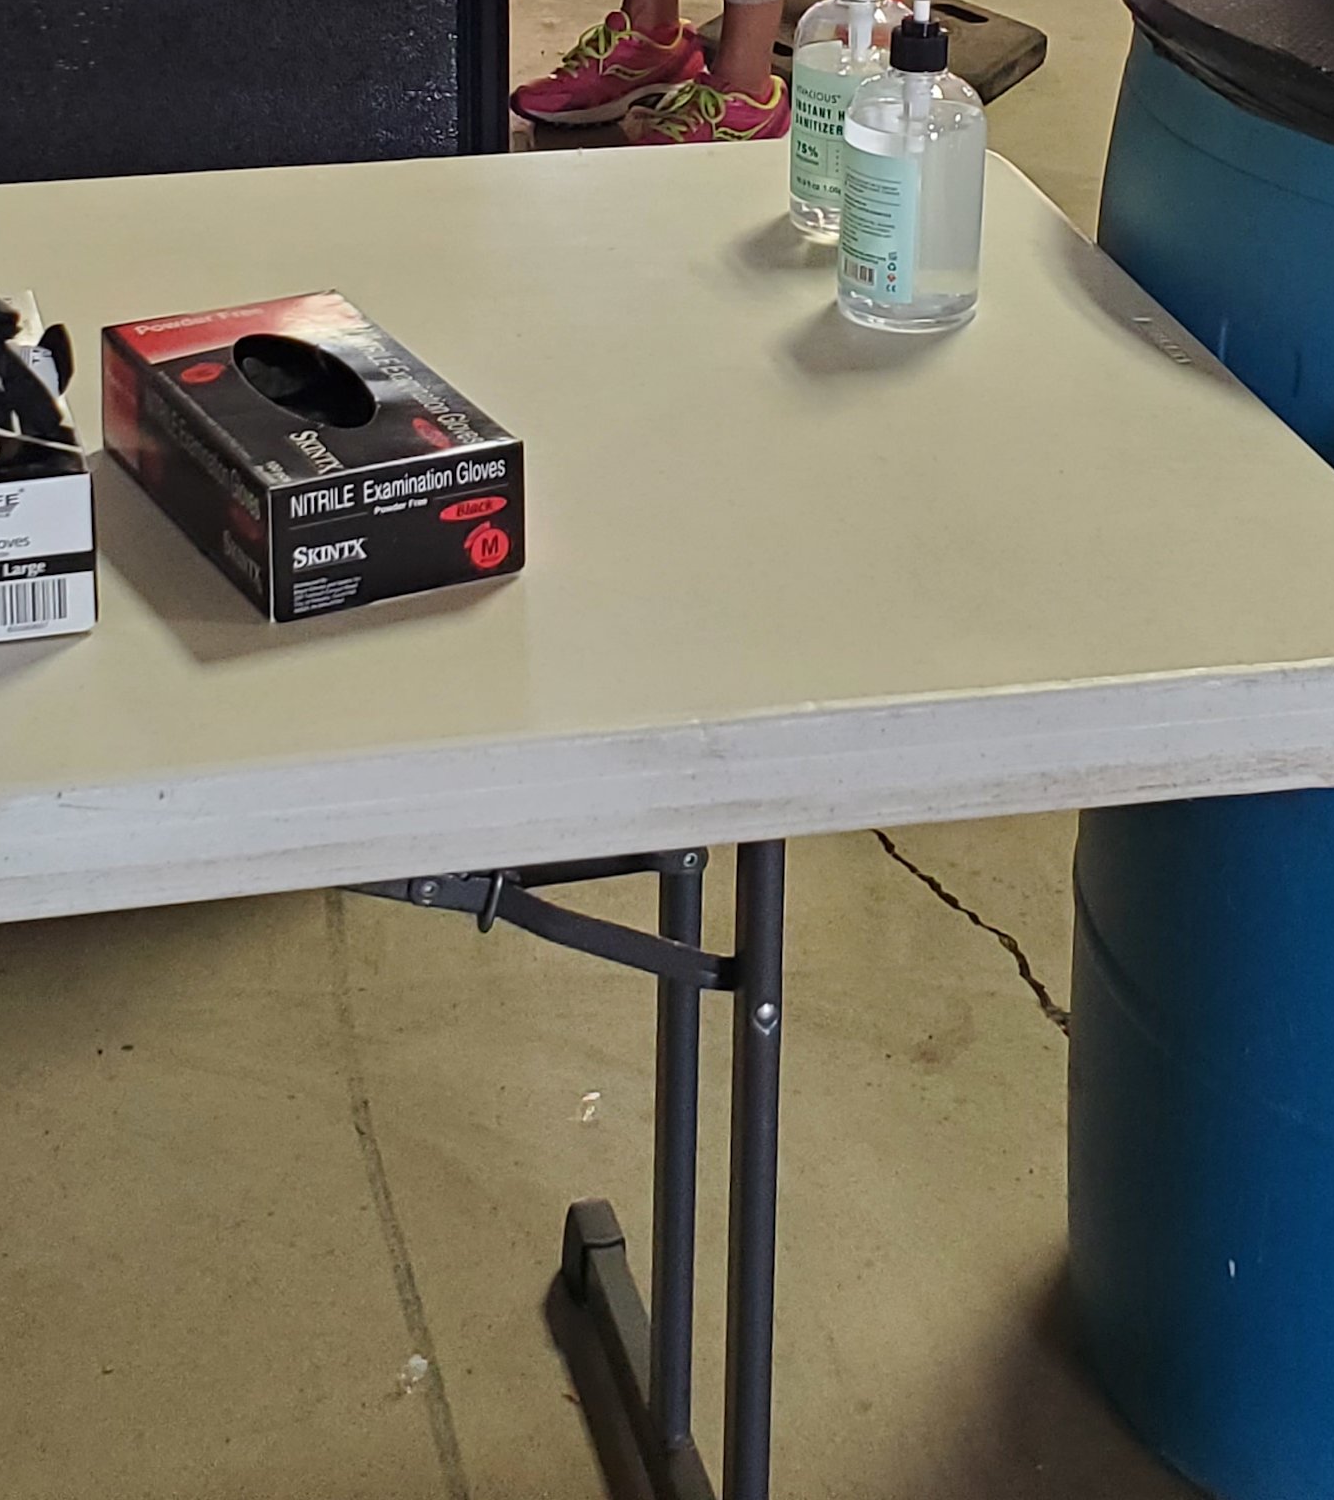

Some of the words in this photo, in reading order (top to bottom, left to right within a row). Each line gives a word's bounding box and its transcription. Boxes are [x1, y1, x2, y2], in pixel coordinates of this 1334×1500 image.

[795, 97, 831, 120] INSTANT
[796, 139, 819, 159] 75%
[134, 315, 212, 336] Powder
[290, 485, 354, 518] NITRILE
[363, 467, 452, 504] Examination
[456, 459, 506, 485] Gloves
[374, 503, 408, 515] Powder
[408, 498, 428, 509] Free
[292, 537, 367, 569] SKINTX
[481, 535, 499, 557] M
[2, 560, 47, 578] Large
